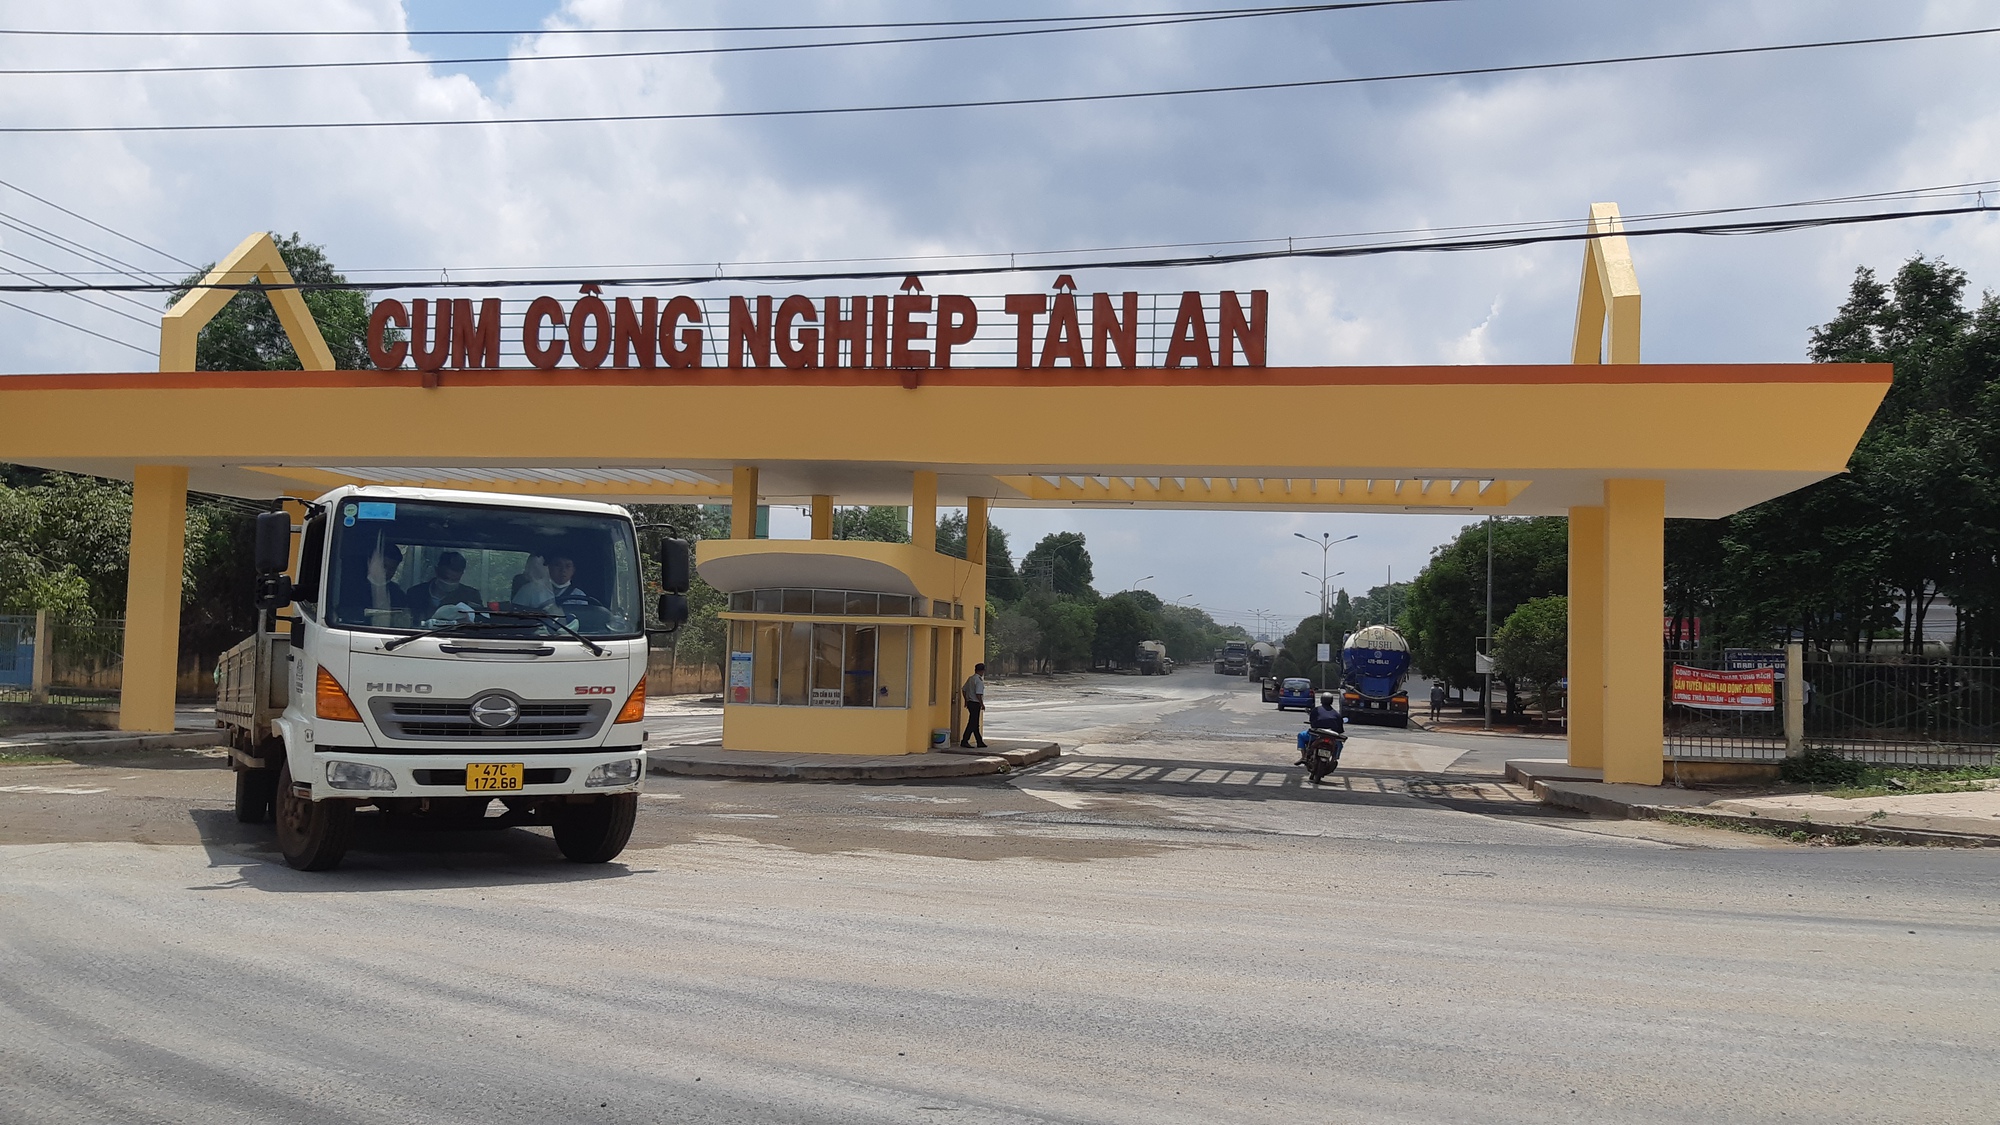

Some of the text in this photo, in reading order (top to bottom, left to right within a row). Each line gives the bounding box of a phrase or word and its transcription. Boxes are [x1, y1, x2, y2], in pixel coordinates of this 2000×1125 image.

[523, 283, 704, 370] CÔNG
[727, 274, 978, 389] NGHIỆP
[1005, 274, 1138, 368] TÂN
[1164, 289, 1268, 368] AN
[1368, 641, 1392, 649] FUSHI
[366, 681, 433, 695] HINO
[574, 685, 616, 696] 500
[1716, 682, 1727, 693] LAO
[483, 764, 508, 776] 47C
[474, 777, 517, 789] 172.68
